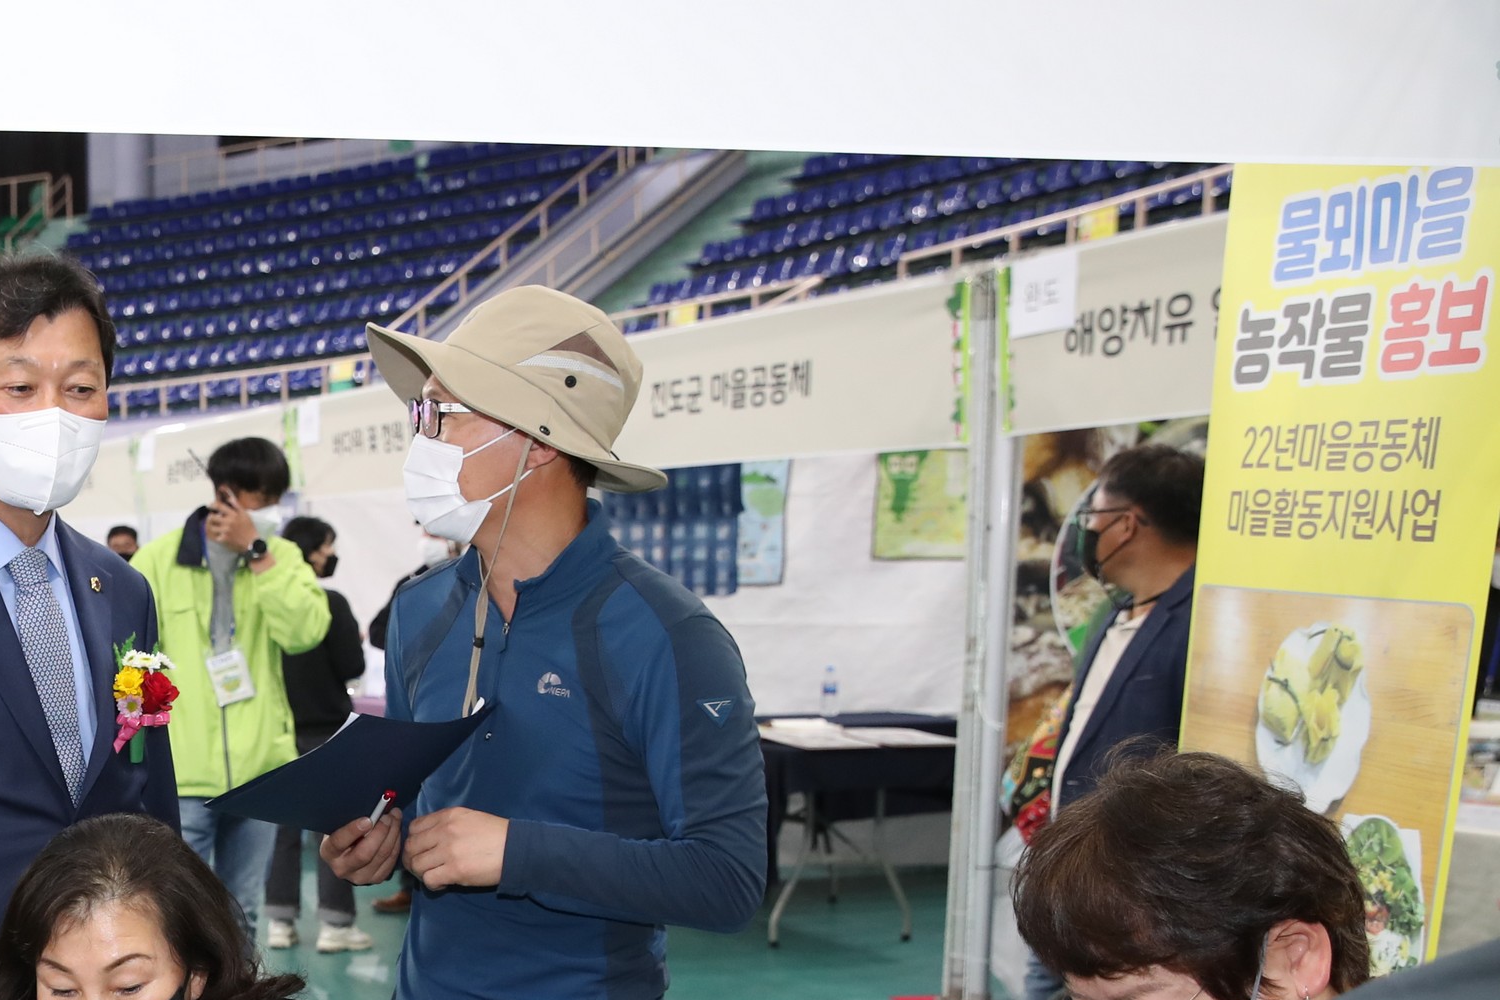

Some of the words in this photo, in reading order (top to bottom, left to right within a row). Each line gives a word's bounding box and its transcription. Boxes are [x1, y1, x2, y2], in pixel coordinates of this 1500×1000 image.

[1234, 292, 1372, 385] 농작물
[1380, 275, 1489, 373] 홍보
[651, 375, 702, 418] 진도군
[710, 358, 812, 411] 마을공동체
[1241, 416, 1442, 473] 22년마을공동체
[1227, 488, 1442, 543] 마을활동지원사업
